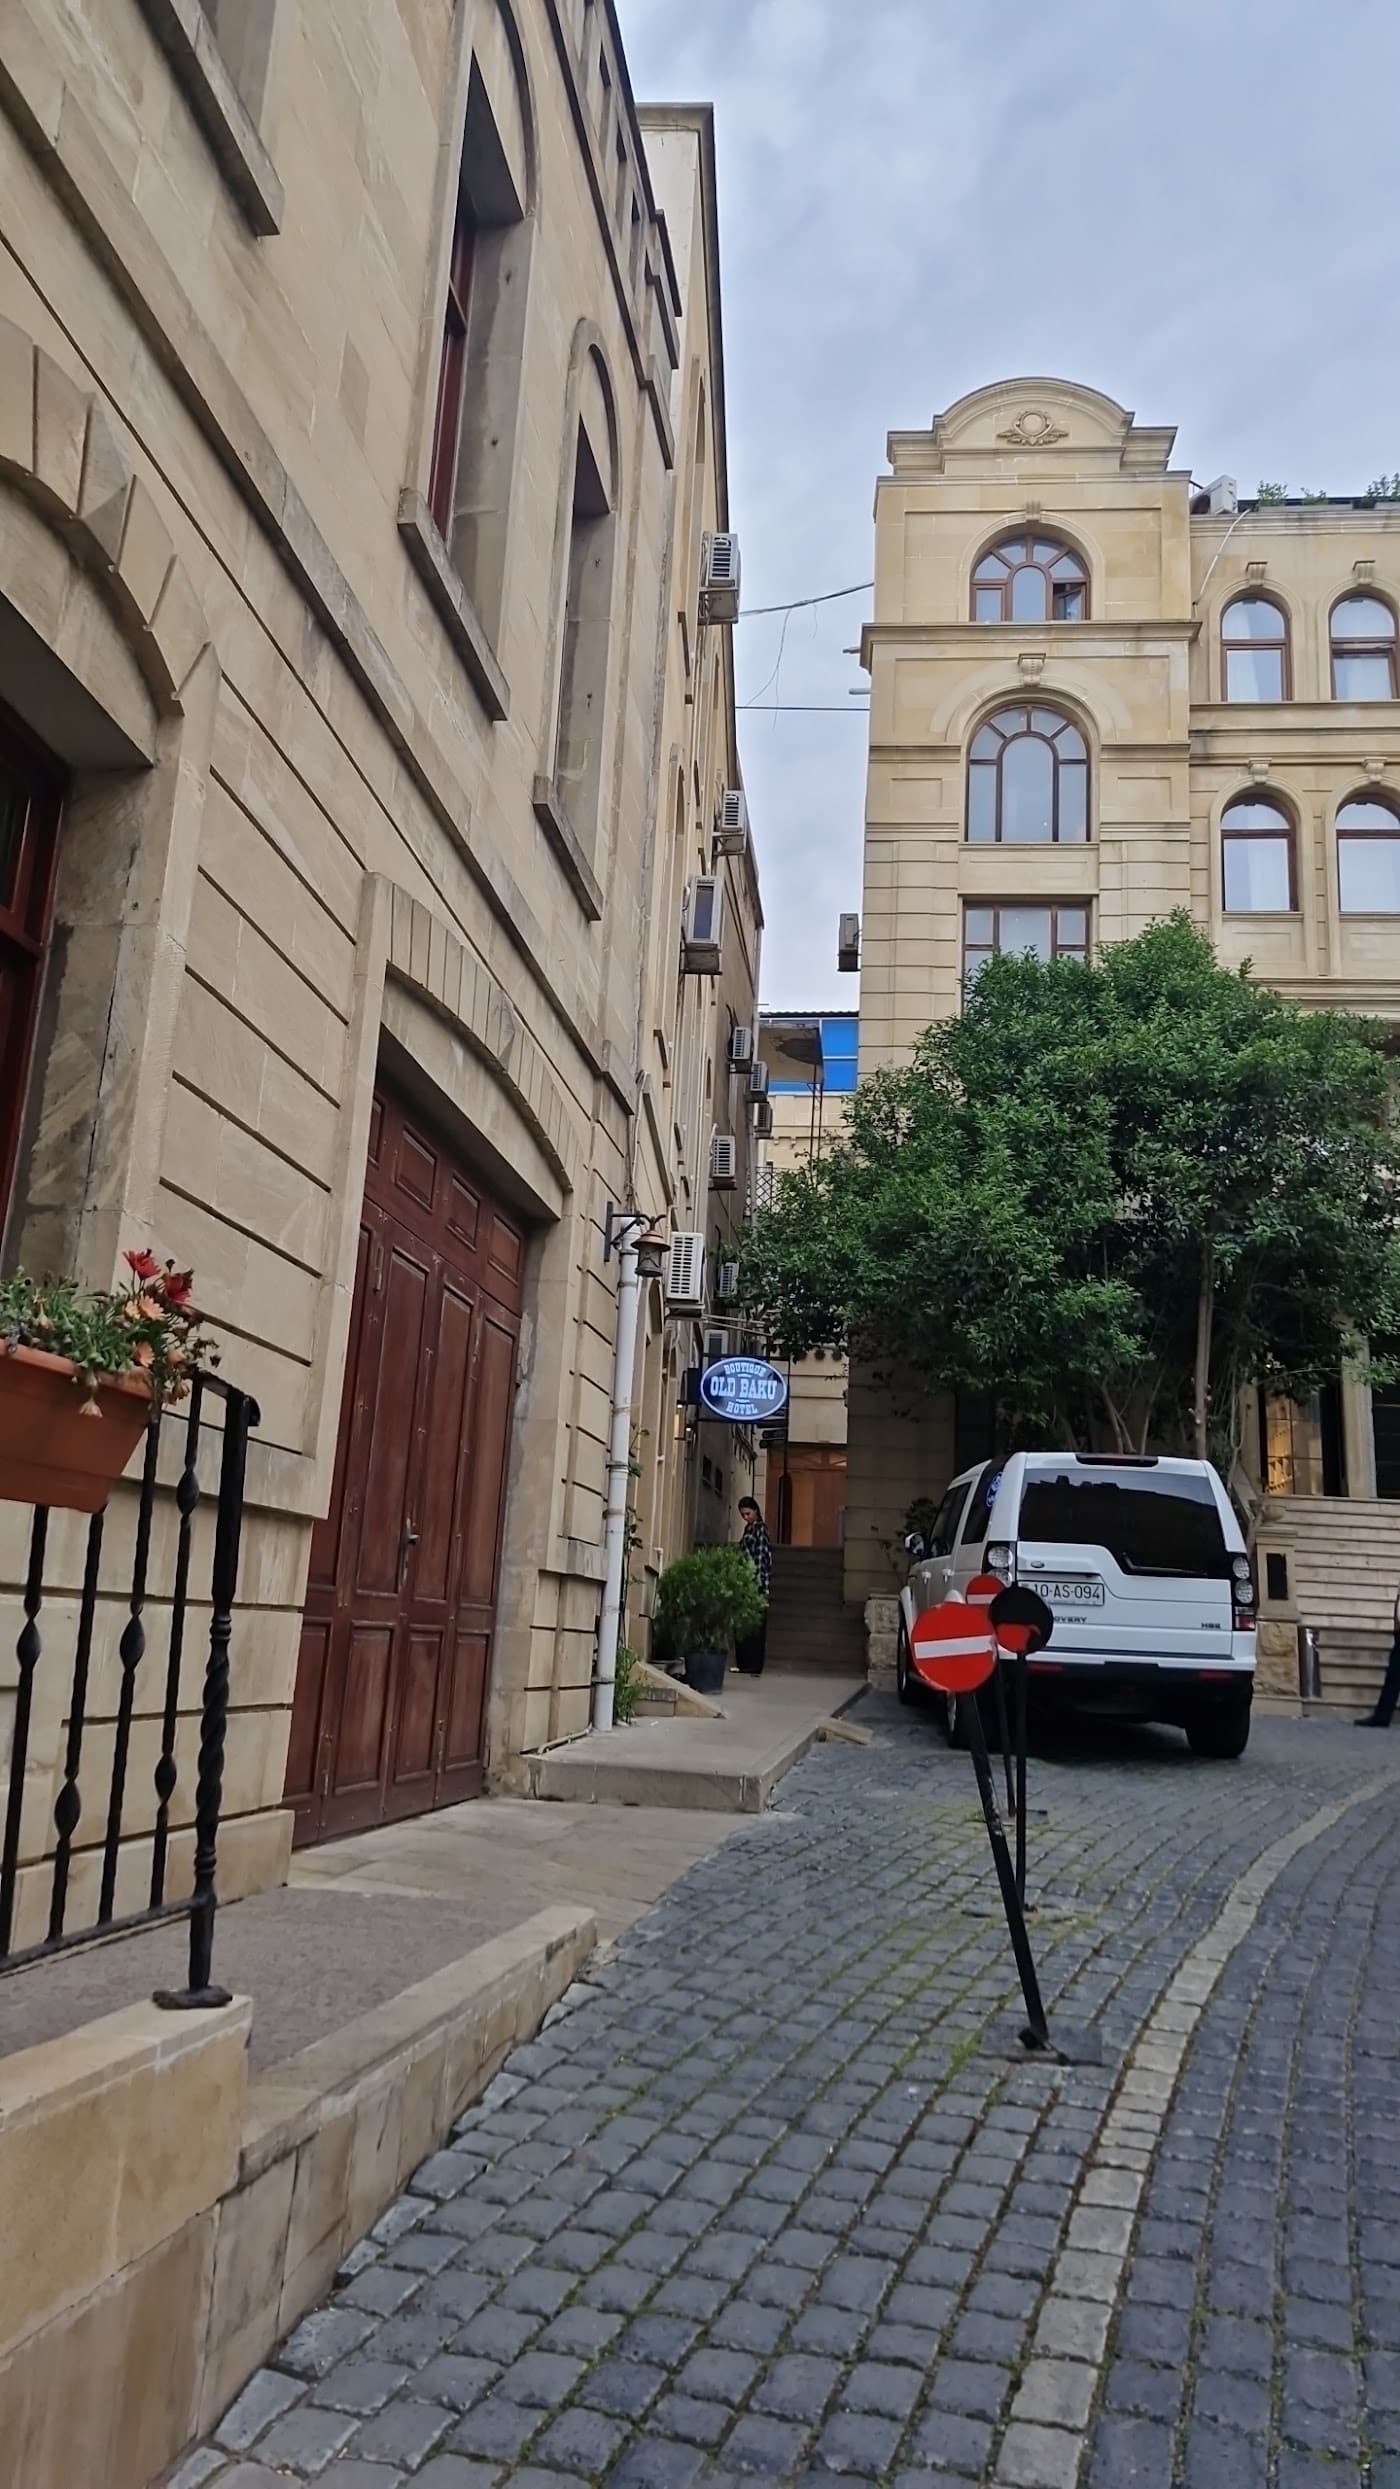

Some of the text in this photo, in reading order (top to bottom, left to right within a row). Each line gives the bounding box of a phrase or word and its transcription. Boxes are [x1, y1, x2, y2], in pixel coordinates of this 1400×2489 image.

[723, 1362, 766, 1377] BOUTIQUE
[710, 1376, 777, 1400] OLD BAKU
[726, 1401, 758, 1415] HOTEL
